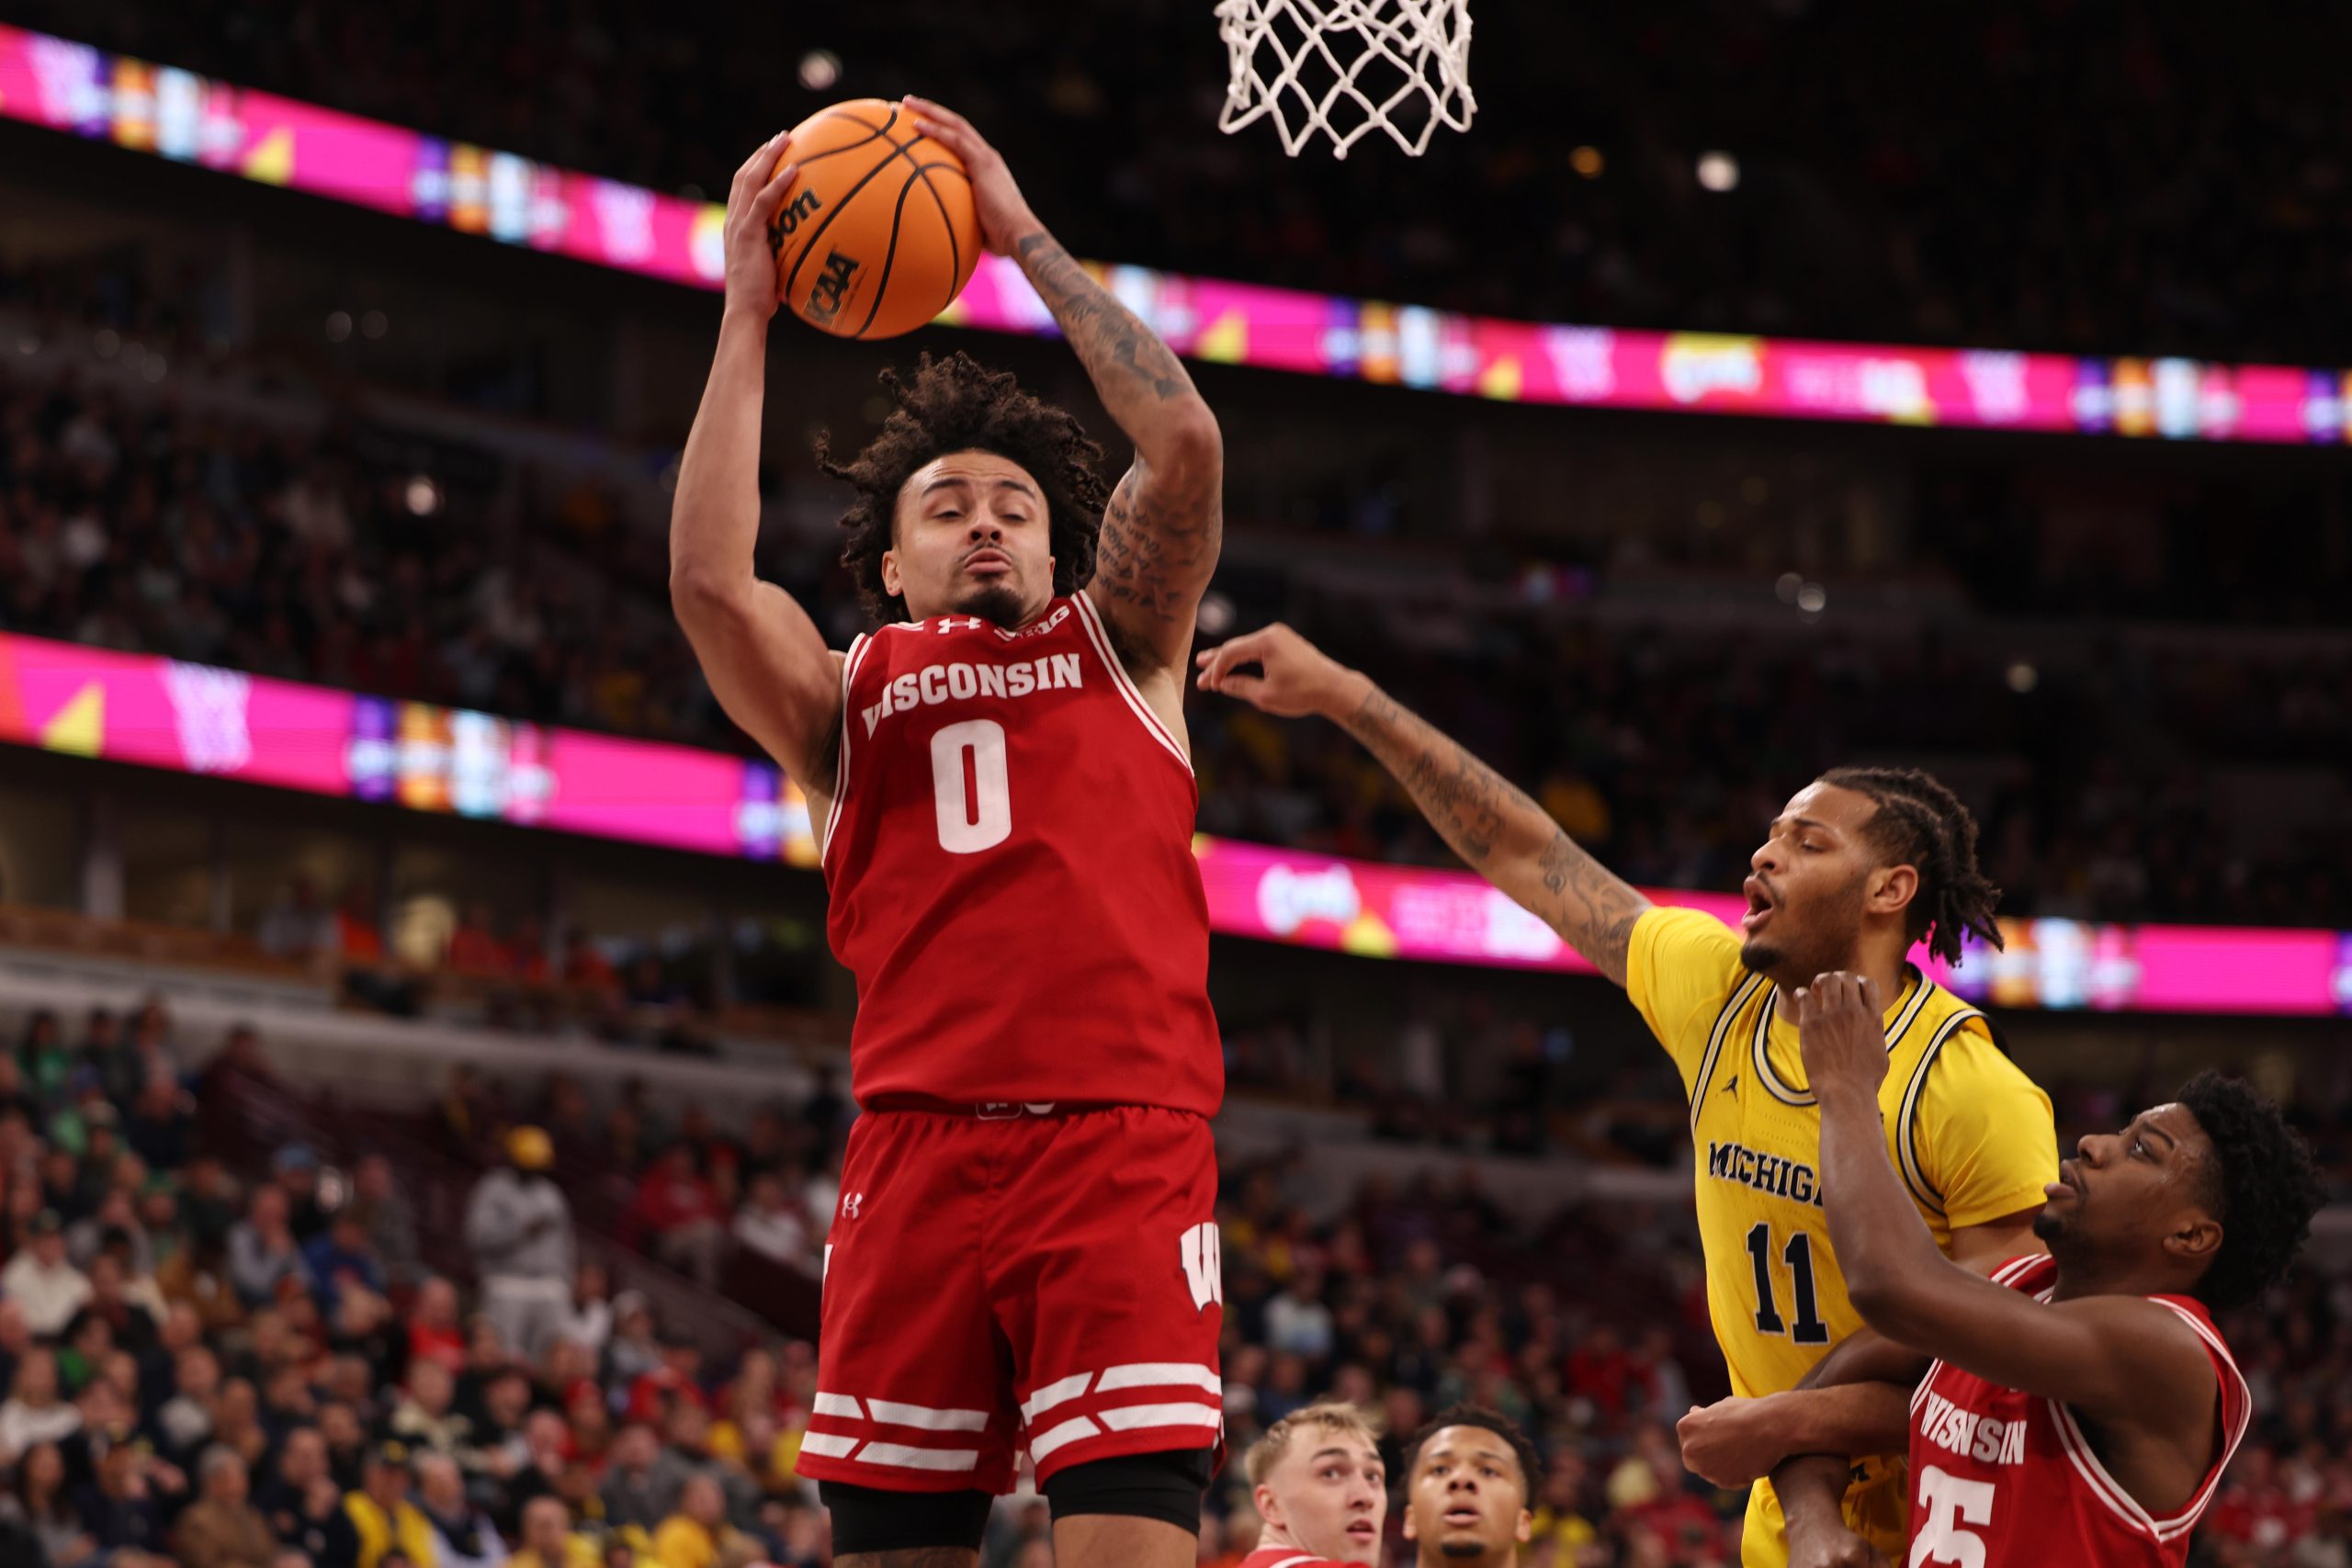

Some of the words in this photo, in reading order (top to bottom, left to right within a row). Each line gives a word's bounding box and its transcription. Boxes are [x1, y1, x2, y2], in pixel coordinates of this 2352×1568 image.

[805, 250, 861, 324] CAA
[930, 719, 1012, 854] 0
[1747, 1220, 1830, 1346] 11
